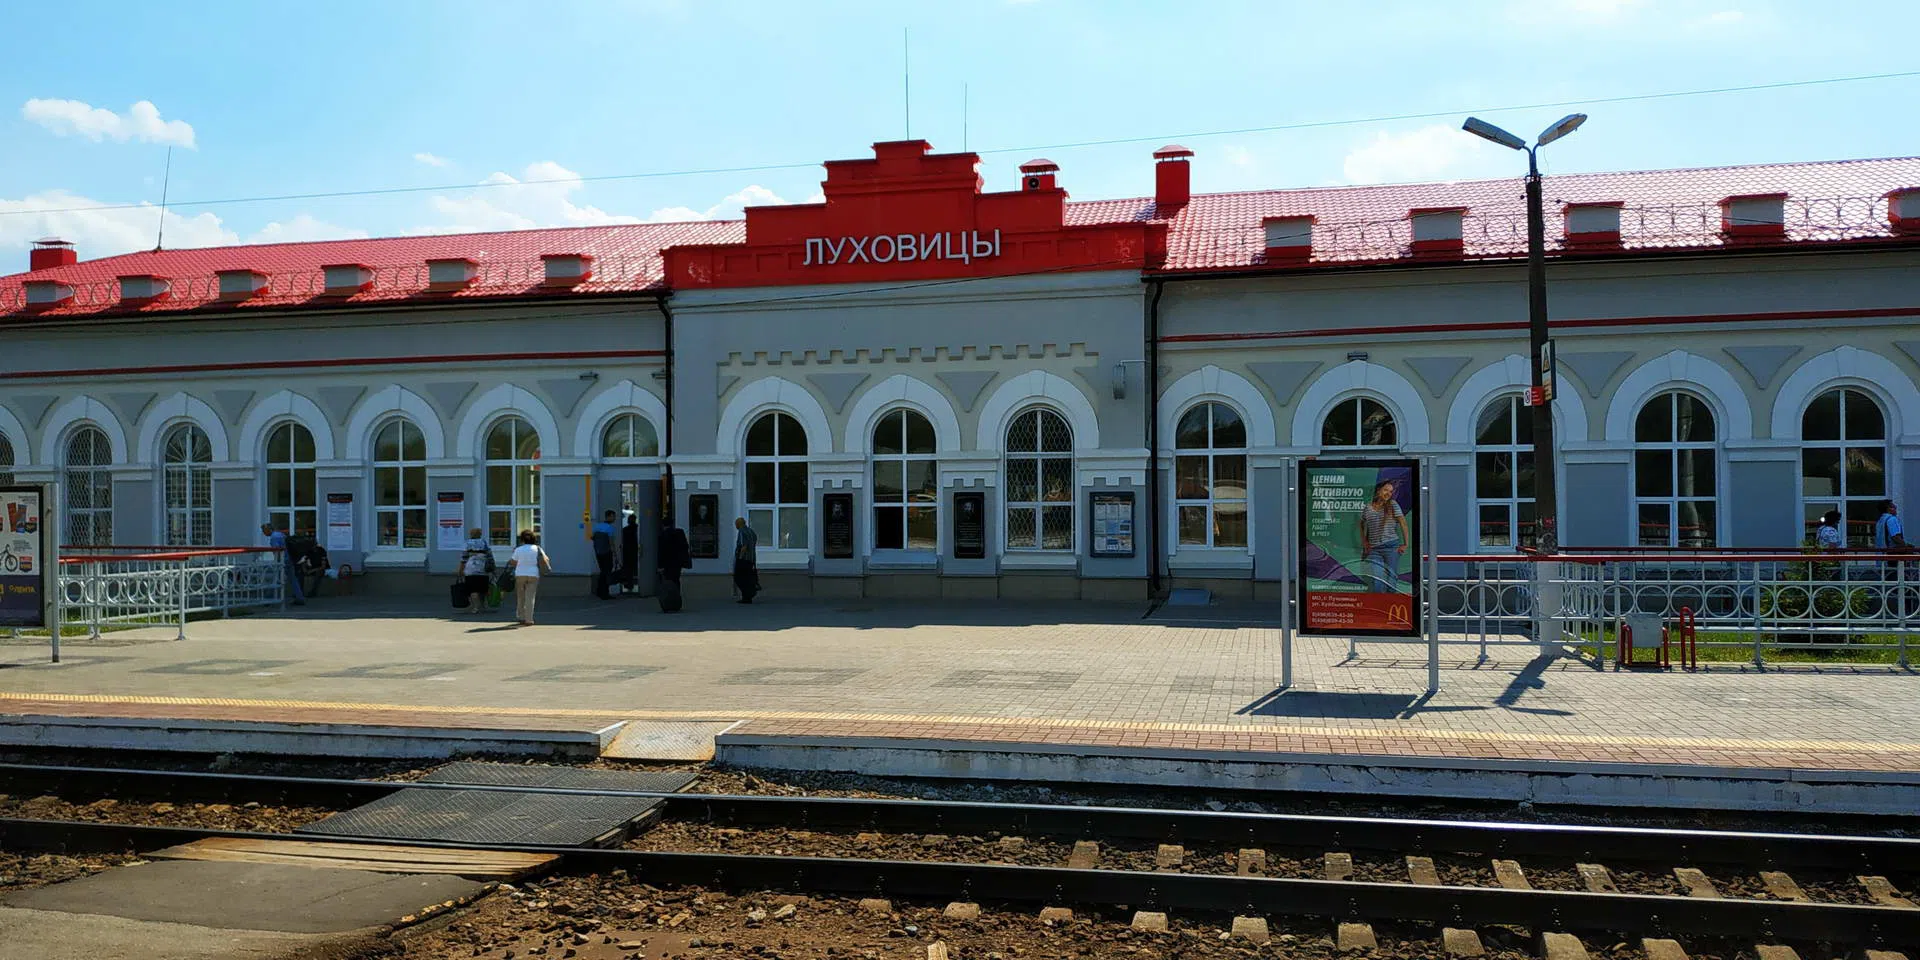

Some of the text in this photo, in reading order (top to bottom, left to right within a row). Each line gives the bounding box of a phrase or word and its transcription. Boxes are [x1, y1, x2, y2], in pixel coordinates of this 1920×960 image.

[803, 229, 1001, 265] ЛУХОВИЦЫ
[1312, 475, 1345, 486] ЦЕНИМ
[1312, 488, 1364, 497] АКТИВНУЮ
[1312, 500, 1366, 511] МОЛОДЕЖЬ
